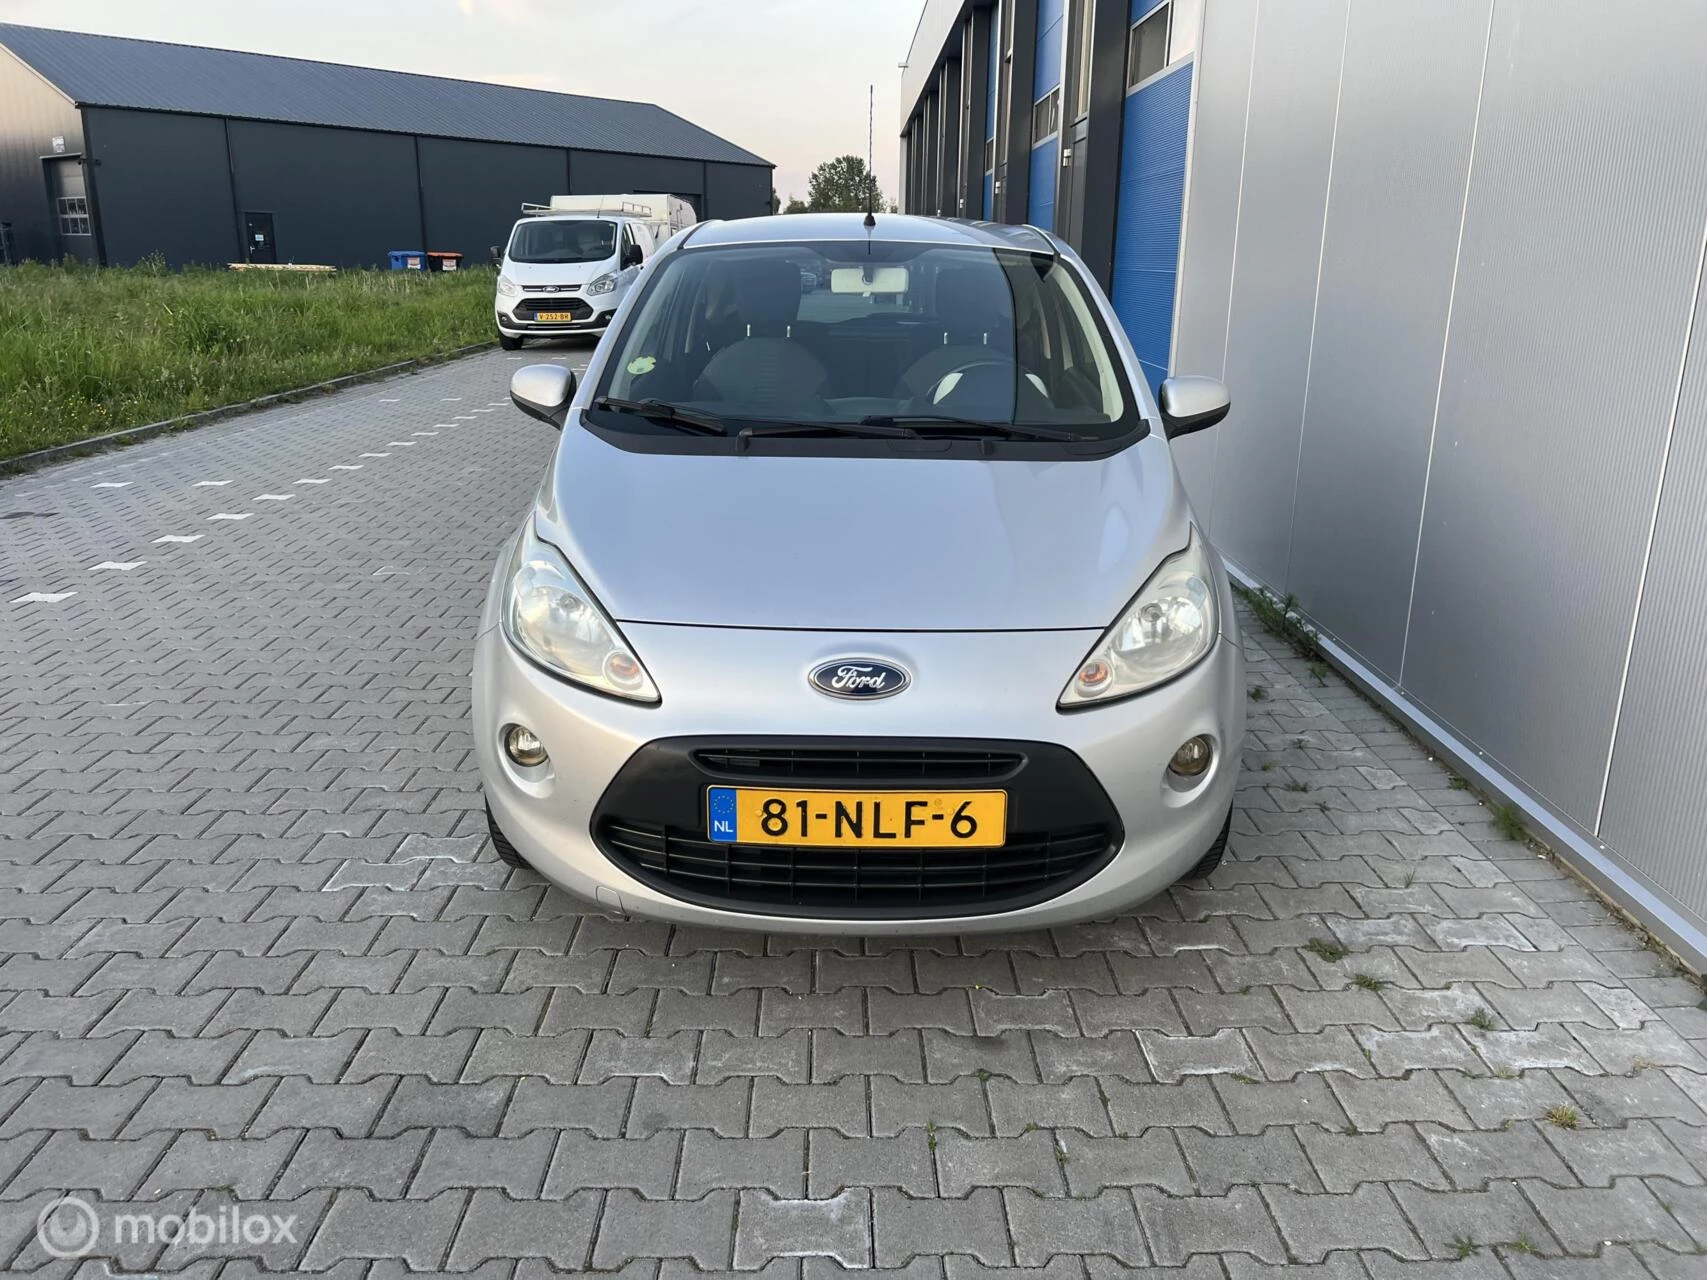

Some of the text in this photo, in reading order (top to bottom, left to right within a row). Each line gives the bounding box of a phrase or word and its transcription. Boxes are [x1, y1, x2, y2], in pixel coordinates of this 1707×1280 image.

[831, 665, 885, 689] Ford
[714, 798, 977, 839] NL 81-NLF-6
